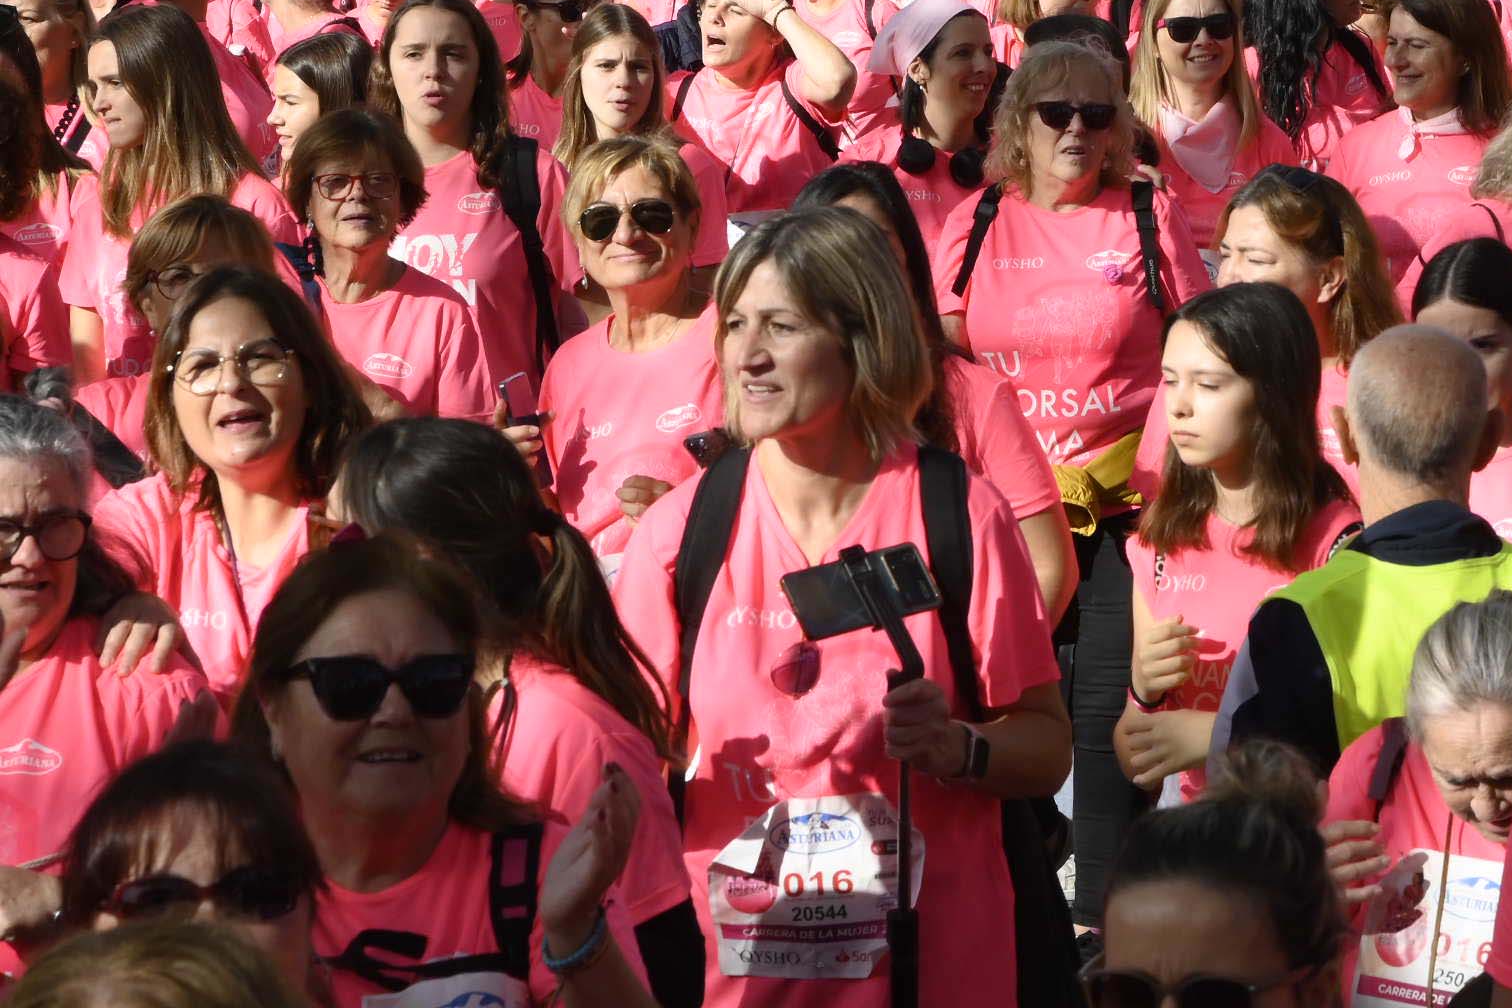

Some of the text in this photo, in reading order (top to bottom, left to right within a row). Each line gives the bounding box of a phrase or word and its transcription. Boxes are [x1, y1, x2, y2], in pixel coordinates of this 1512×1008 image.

[518, 122, 541, 136] HO
[1369, 170, 1412, 186] OYSHO
[903, 190, 944, 204] YSHO
[993, 256, 1044, 270] OYSHO
[981, 350, 1022, 378] TU
[726, 606, 796, 630] OYSHO
[783, 869, 854, 898] 016
[791, 904, 847, 923] 20544
[742, 925, 878, 939] CARRERA DE LA MUJER
[739, 949, 801, 966] OYSHO
[1378, 983, 1427, 1003] CARRERA
